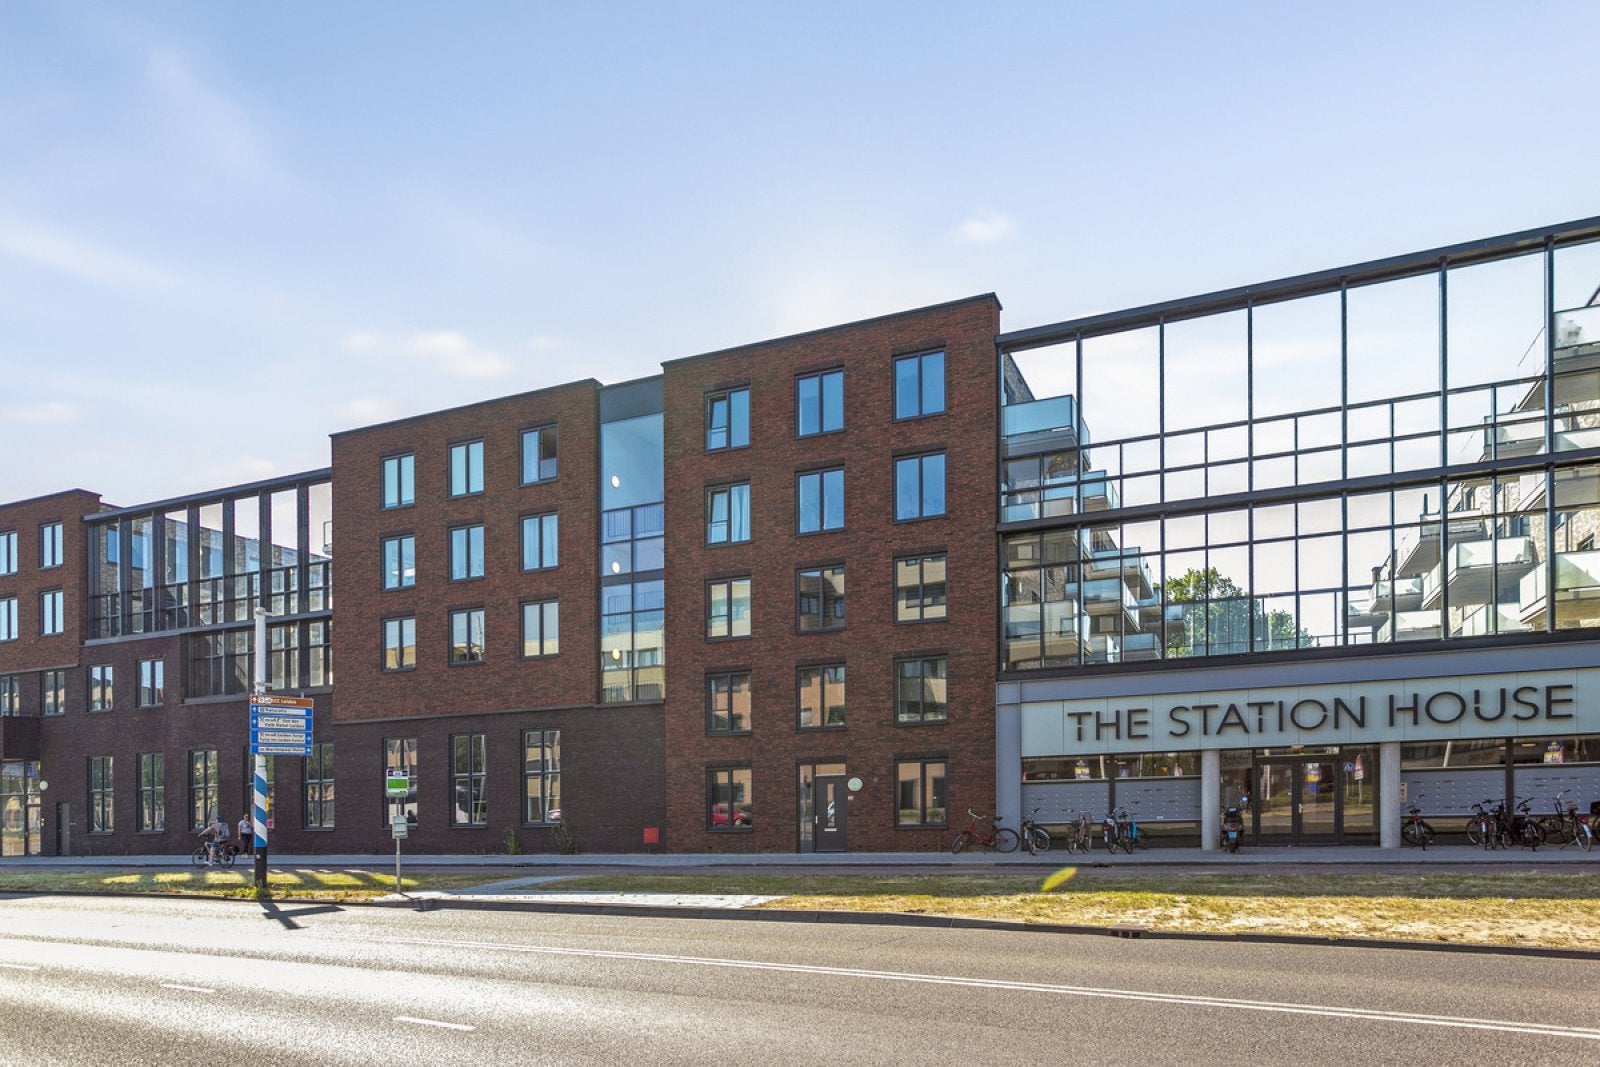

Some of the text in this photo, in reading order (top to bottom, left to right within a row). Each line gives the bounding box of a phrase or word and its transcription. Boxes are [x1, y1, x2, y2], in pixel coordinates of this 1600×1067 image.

[1067, 683, 1574, 742] THE STATION HOUSE
